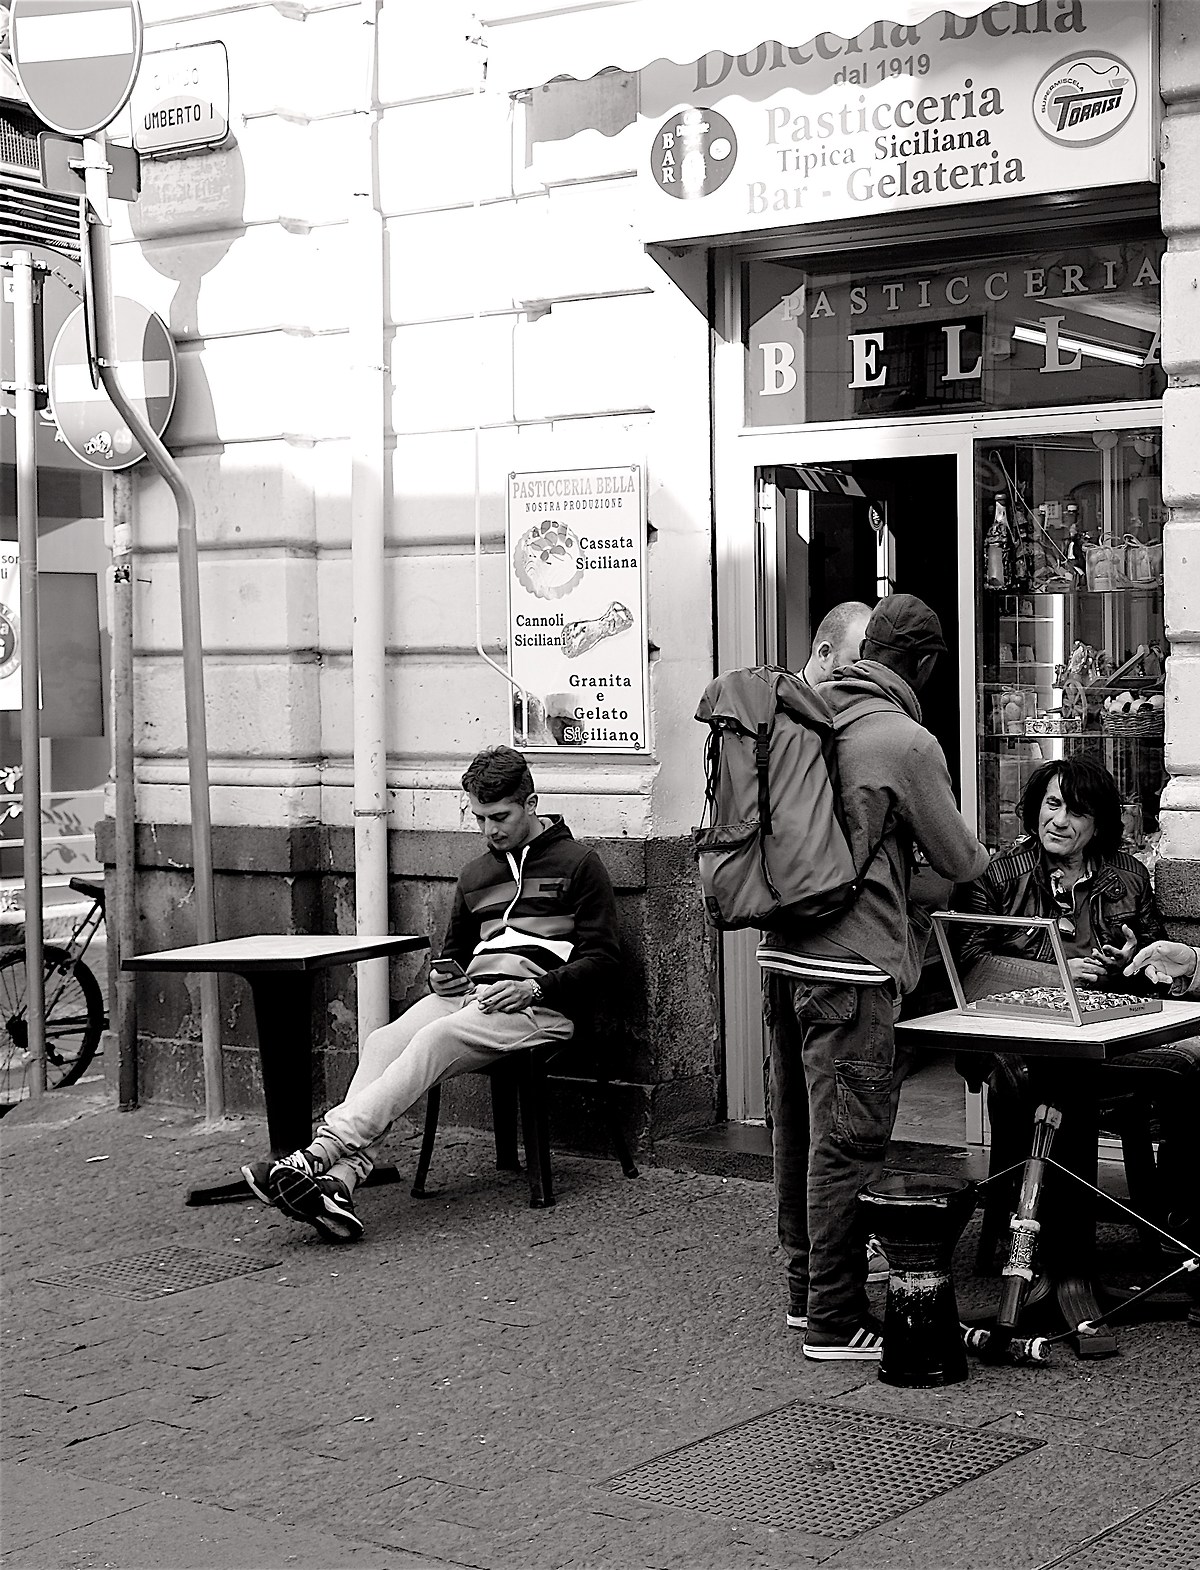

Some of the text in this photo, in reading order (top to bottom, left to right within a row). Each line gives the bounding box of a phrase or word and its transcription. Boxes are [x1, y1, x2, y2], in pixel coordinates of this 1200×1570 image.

[834, 54, 930, 86] dal 1919
[144, 103, 202, 130] UMBERTO
[765, 78, 1005, 146] Pasticceria
[1054, 88, 1124, 132] TORRISI
[661, 132, 677, 184] BAR
[776, 128, 993, 178] Tipica Siciliana
[746, 180, 809, 215] Bar
[846, 150, 1027, 202] Gelateria
[781, 256, 1161, 322] PASTICCERIA
[513, 475, 636, 498] PASTICCERIA BELLA
[525, 497, 623, 512] NOSTRA PRODUZIONE
[579, 536, 634, 550] Cassata
[576, 556, 638, 570] Siciliana
[516, 613, 565, 627] Cannoli
[514, 633, 568, 646] Siciliani
[569, 673, 632, 687] Granita
[596, 692, 605, 701] e
[574, 707, 629, 720] Gelato
[564, 727, 639, 742] Siciliano
